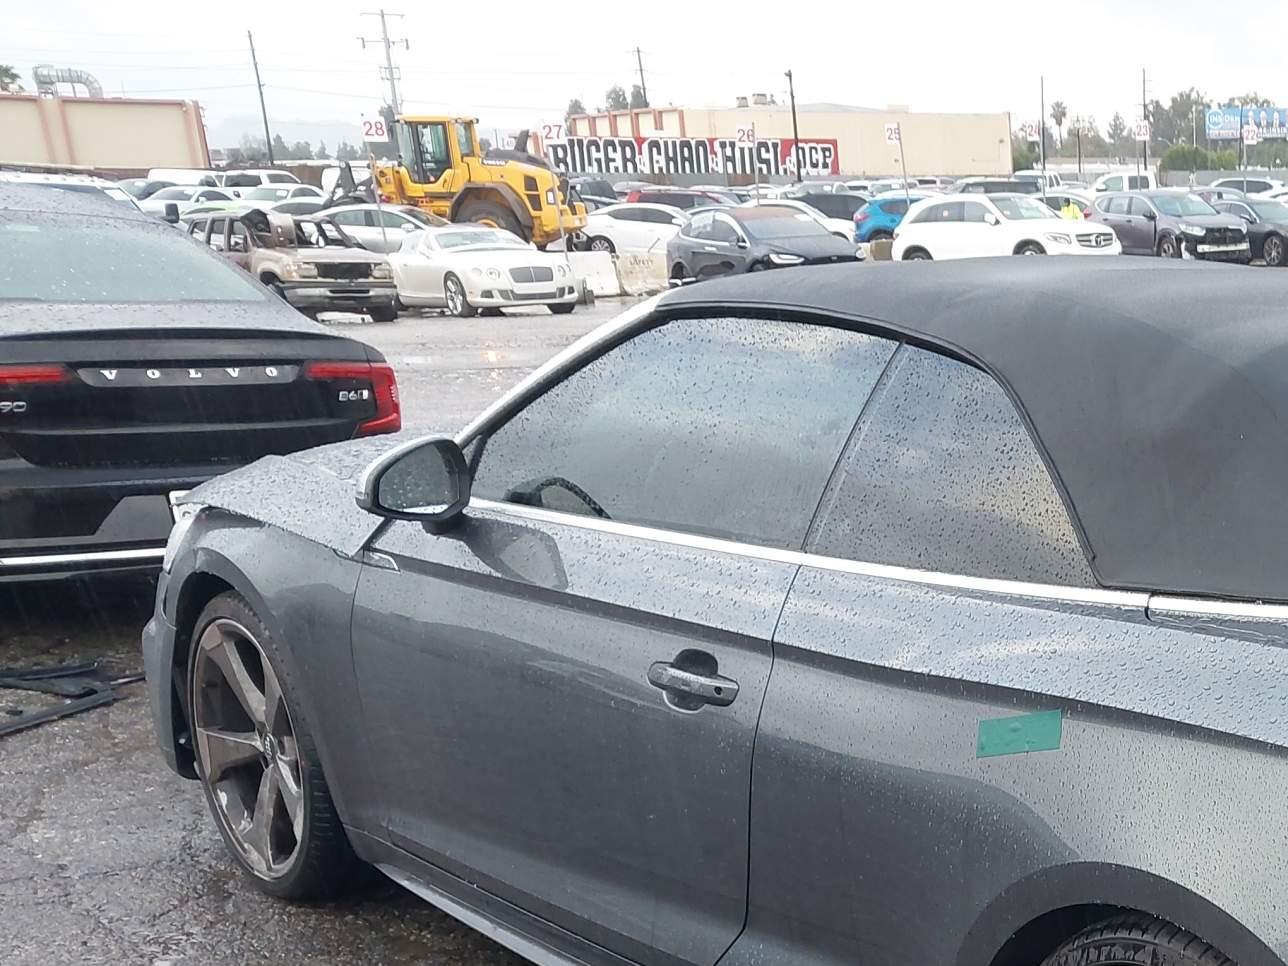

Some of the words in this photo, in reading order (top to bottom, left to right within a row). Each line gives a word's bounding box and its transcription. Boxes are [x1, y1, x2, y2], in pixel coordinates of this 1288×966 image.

[363, 121, 386, 137] 28
[542, 124, 563, 140] 27
[736, 128, 755, 143] 26
[886, 127, 900, 141] 25
[1136, 125, 1150, 137] 23
[100, 367, 278, 381] VOLVO
